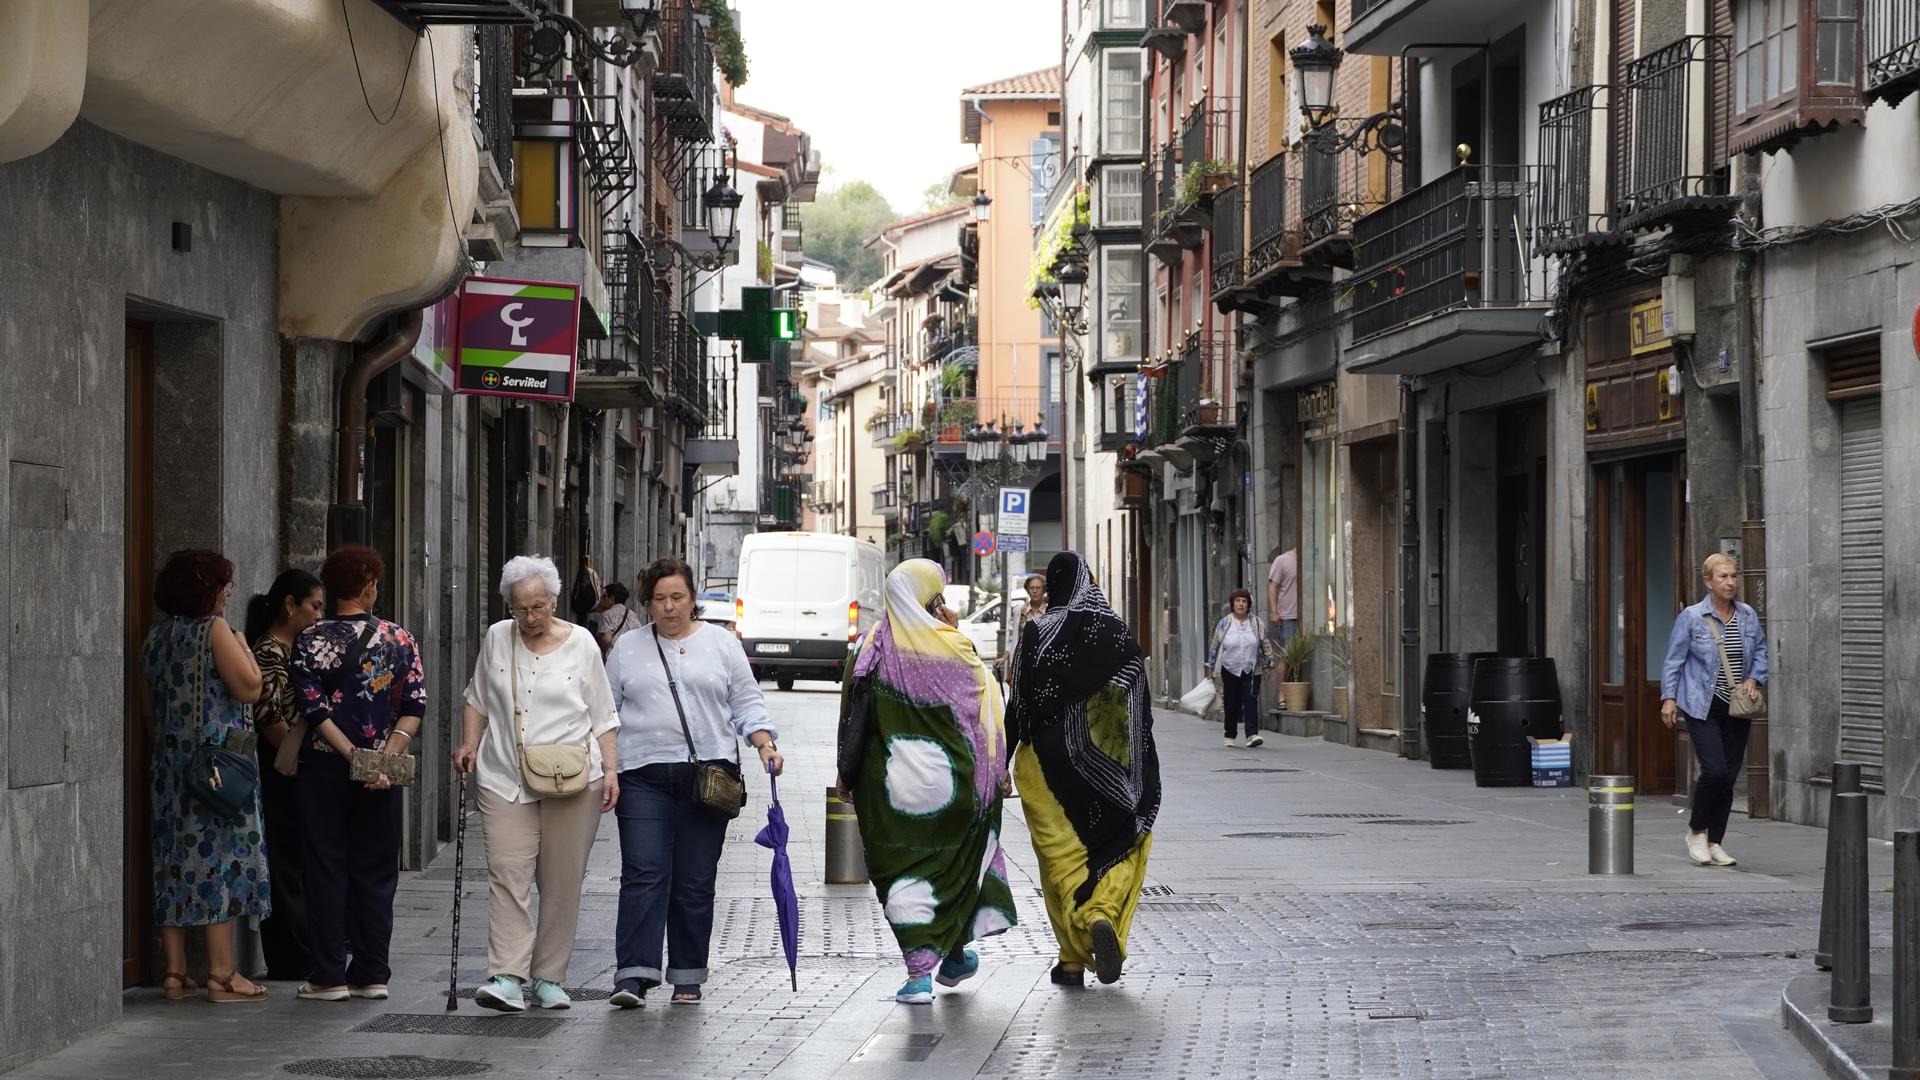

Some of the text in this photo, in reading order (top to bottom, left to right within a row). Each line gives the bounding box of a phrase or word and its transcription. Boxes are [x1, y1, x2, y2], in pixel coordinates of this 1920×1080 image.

[781, 312, 793, 338] L
[503, 376, 547, 389] ServiRed
[1007, 493, 1022, 511] P
